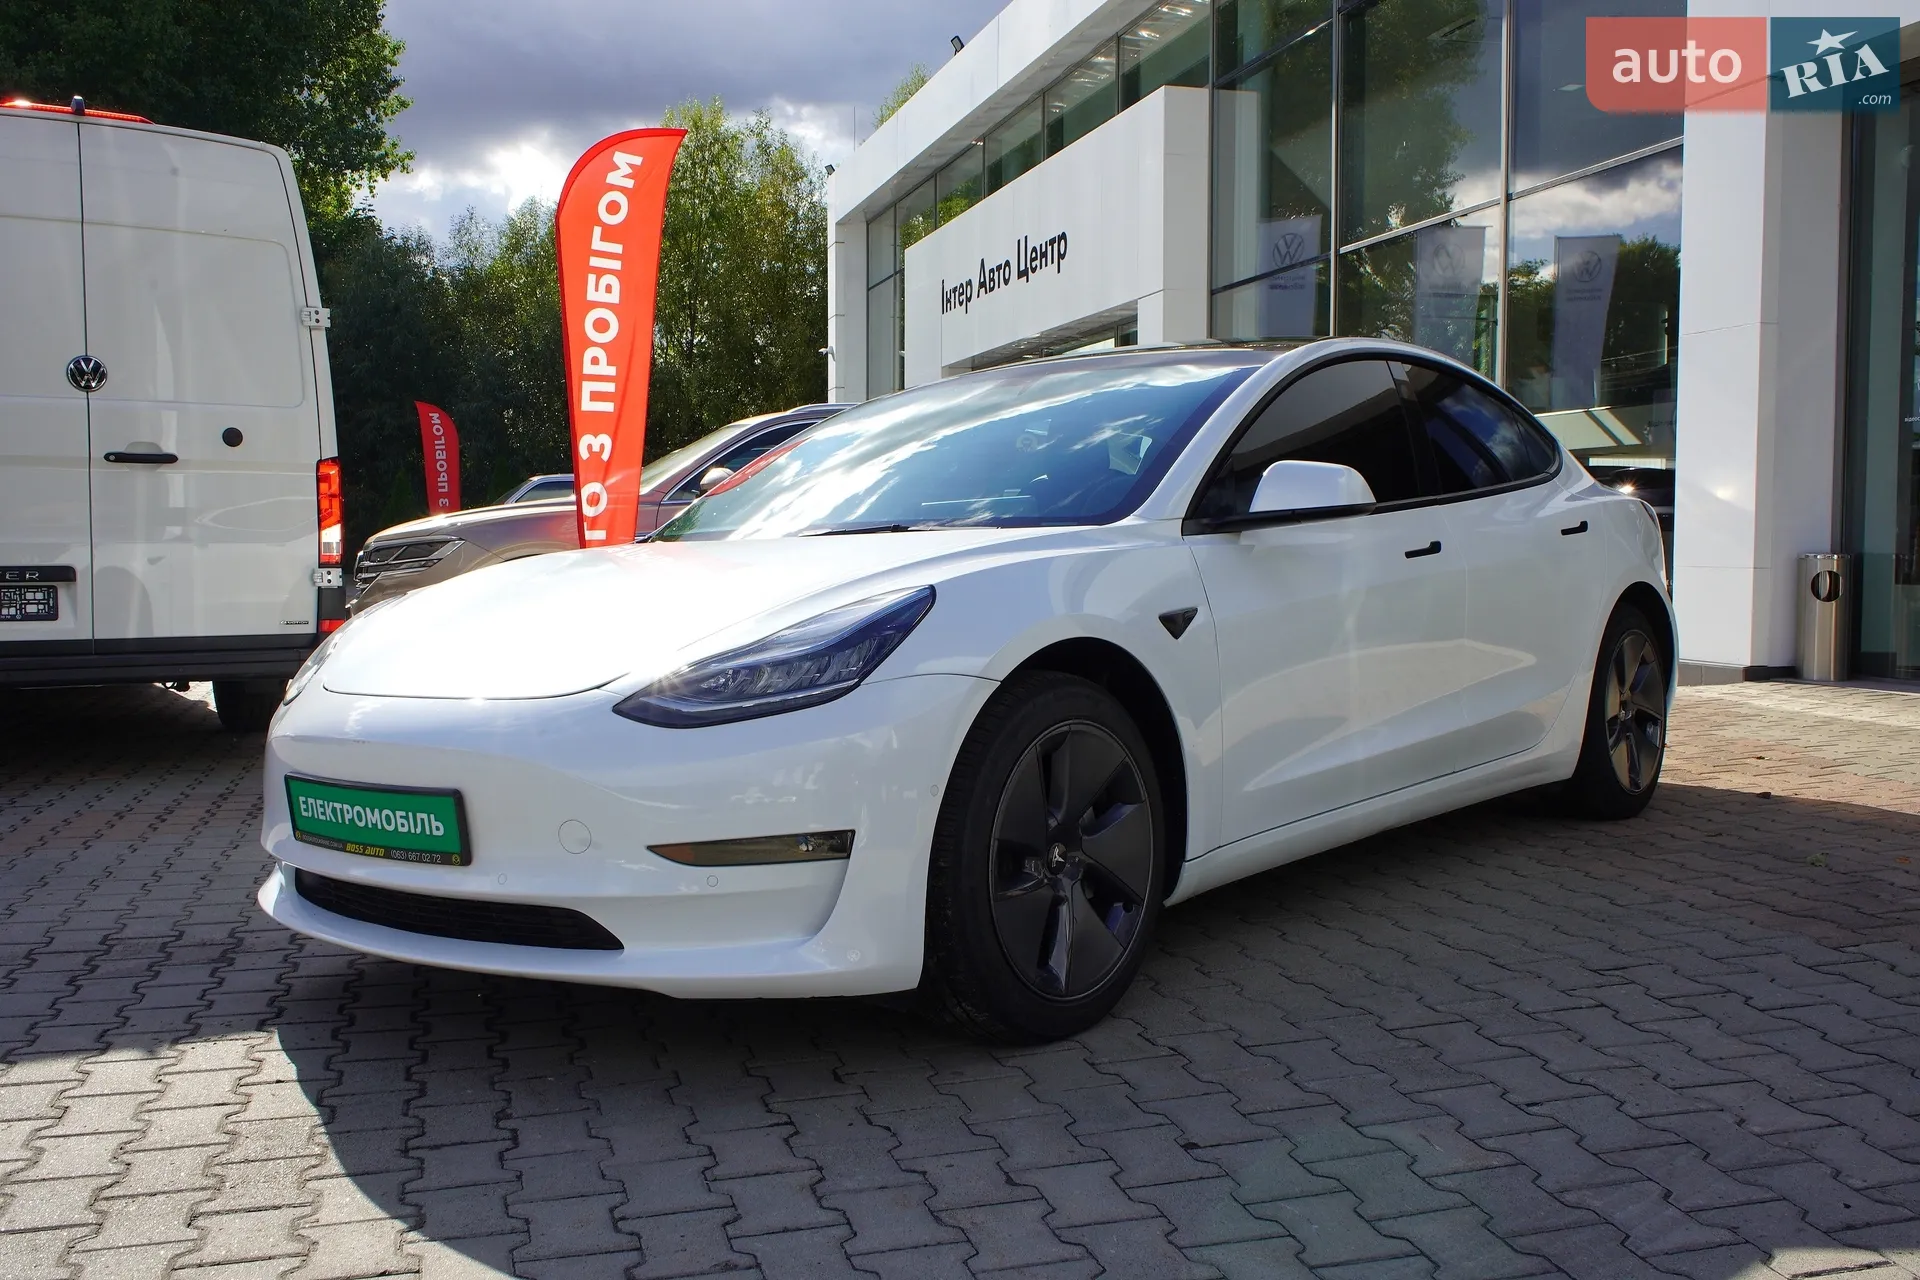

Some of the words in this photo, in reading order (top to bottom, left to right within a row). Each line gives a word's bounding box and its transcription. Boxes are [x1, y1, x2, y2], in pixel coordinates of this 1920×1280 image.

[580, 149, 644, 414] ПРОБІГОМ
[941, 278, 973, 315] Інтер
[977, 257, 1012, 299] Авто
[1017, 230, 1068, 284] Центр
[578, 432, 613, 462] З
[0, 570, 39, 580] ER
[298, 796, 445, 837] ЕЛЕКТРОМОБІЛЬ
[345, 843, 364, 853] BOSS
[390, 850, 407, 860] (063)
[408, 851, 420, 861] 667
[421, 853, 431, 862] 02
[432, 854, 442, 863] 72
